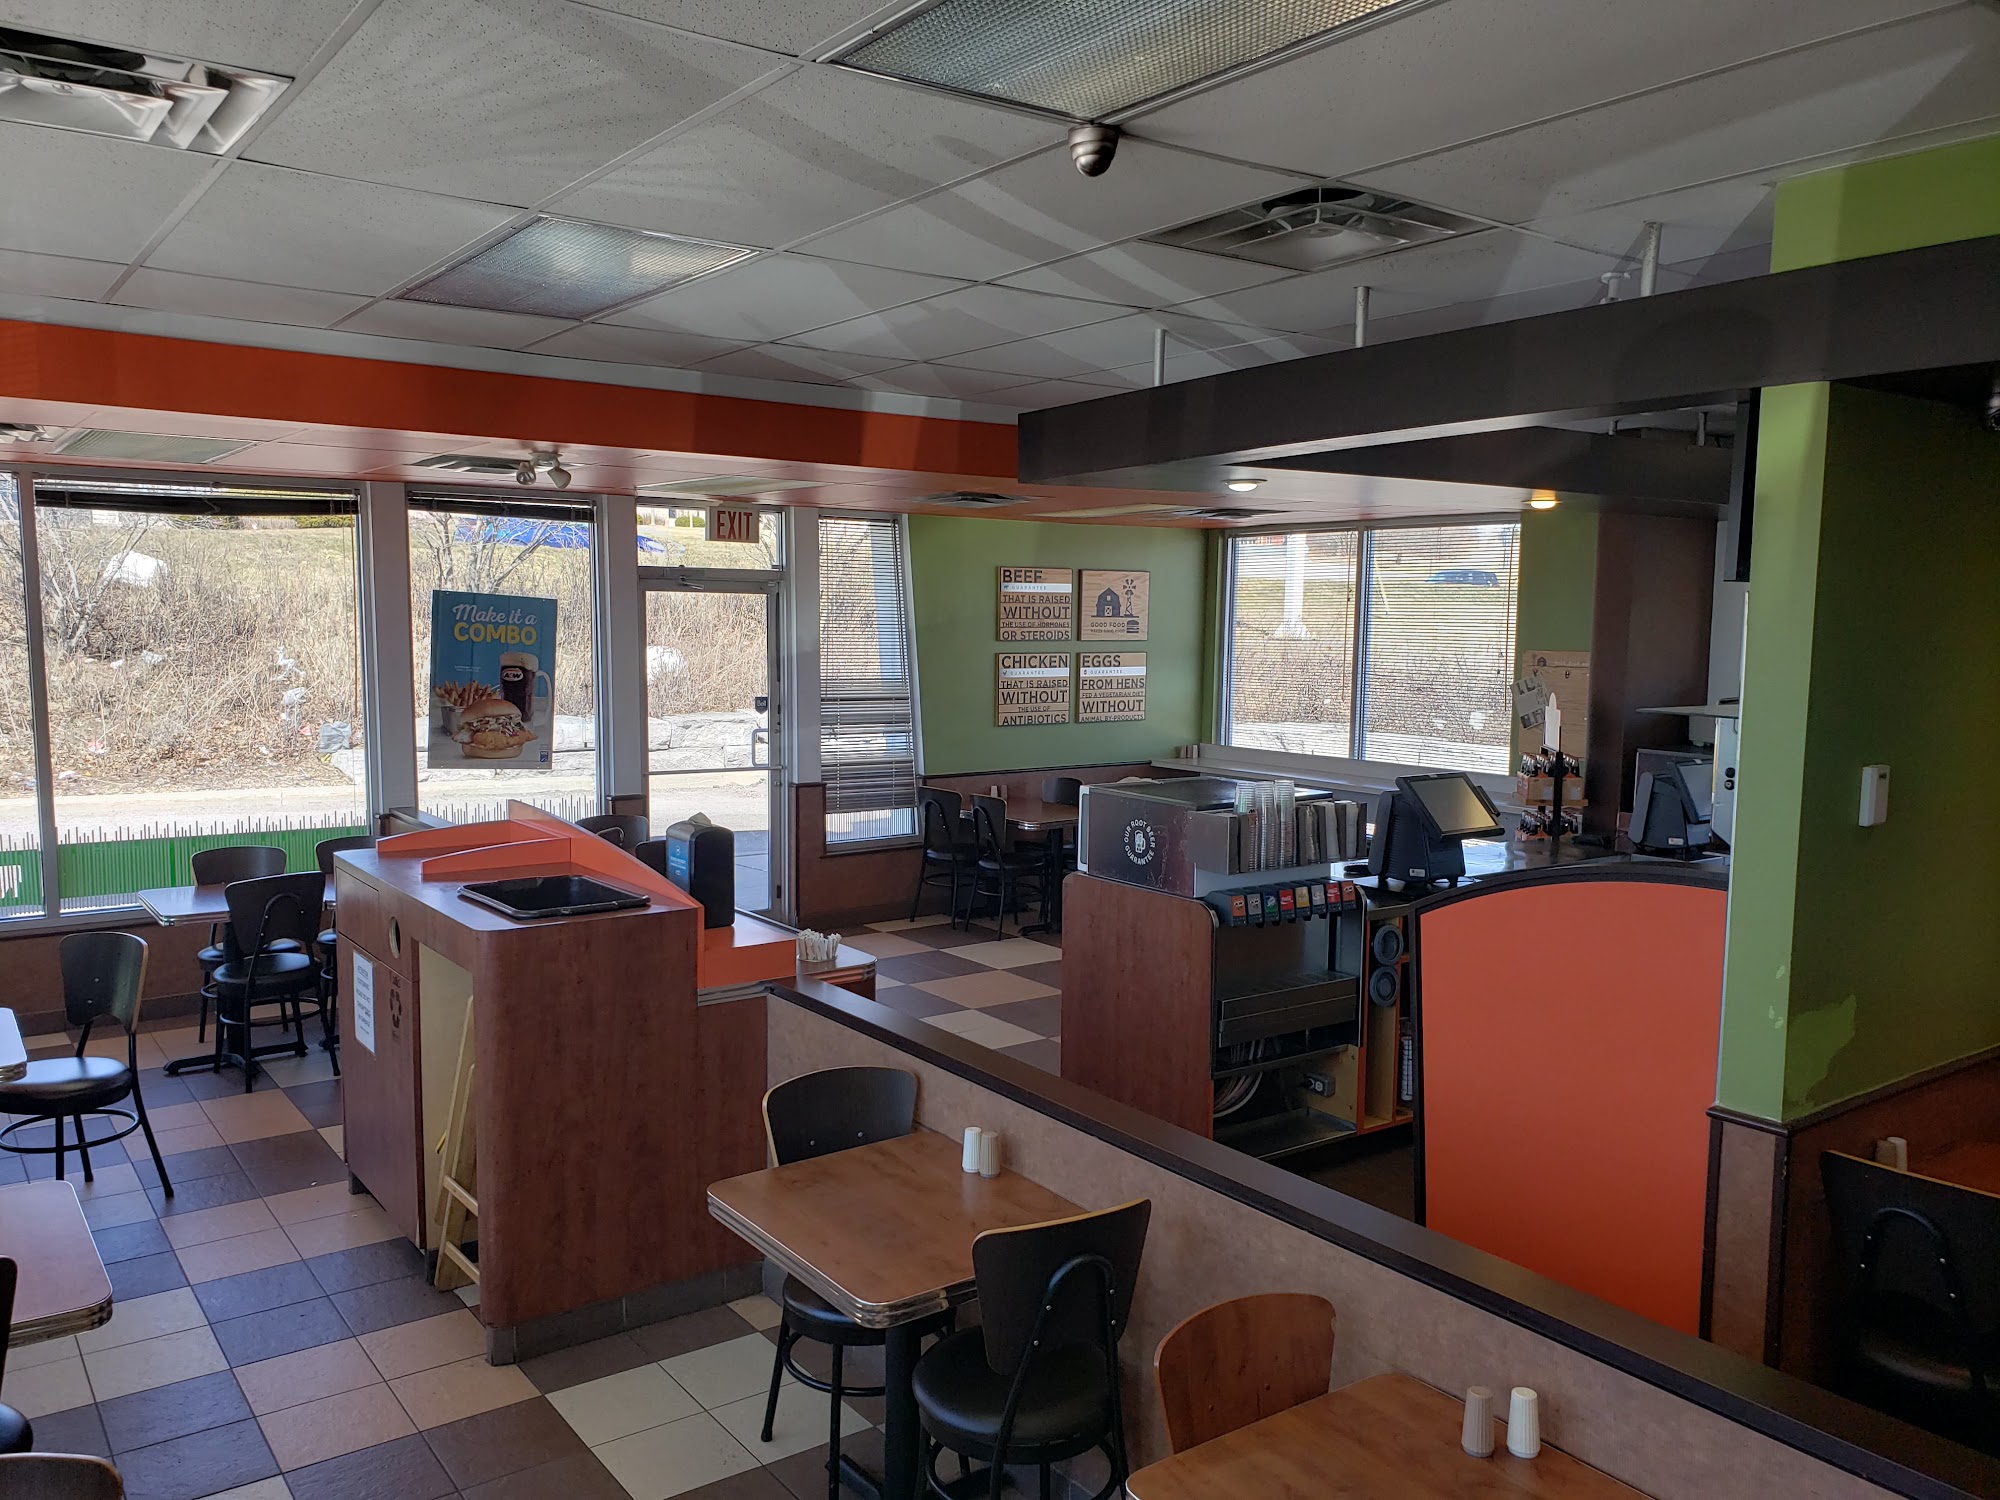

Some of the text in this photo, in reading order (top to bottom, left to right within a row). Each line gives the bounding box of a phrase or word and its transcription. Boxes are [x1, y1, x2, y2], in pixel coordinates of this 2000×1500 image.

[717, 510, 753, 540] EXIT
[1003, 569, 1043, 583] BEEF
[1002, 595, 1070, 603] THAT IS RAISED
[452, 604, 538, 625] Make it a
[1003, 606, 1070, 619] WITHOUT
[454, 622, 537, 645] COMBO
[1002, 631, 1069, 640] OR STEROIDS
[1002, 655, 1068, 669] CHICKEN
[1082, 655, 1121, 667] EGGS
[1001, 679, 1068, 689] THAT IS RAISED
[1082, 678, 1144, 690] FROM HENS
[1001, 690, 1067, 704] WITHOUT
[1082, 700, 1143, 713] WITHOUT
[1002, 714, 1066, 726] ANTIBIOTICS
[1124, 819, 1156, 848] OUR ROOT BEER
[1125, 845, 1155, 865] GUARANTEE
